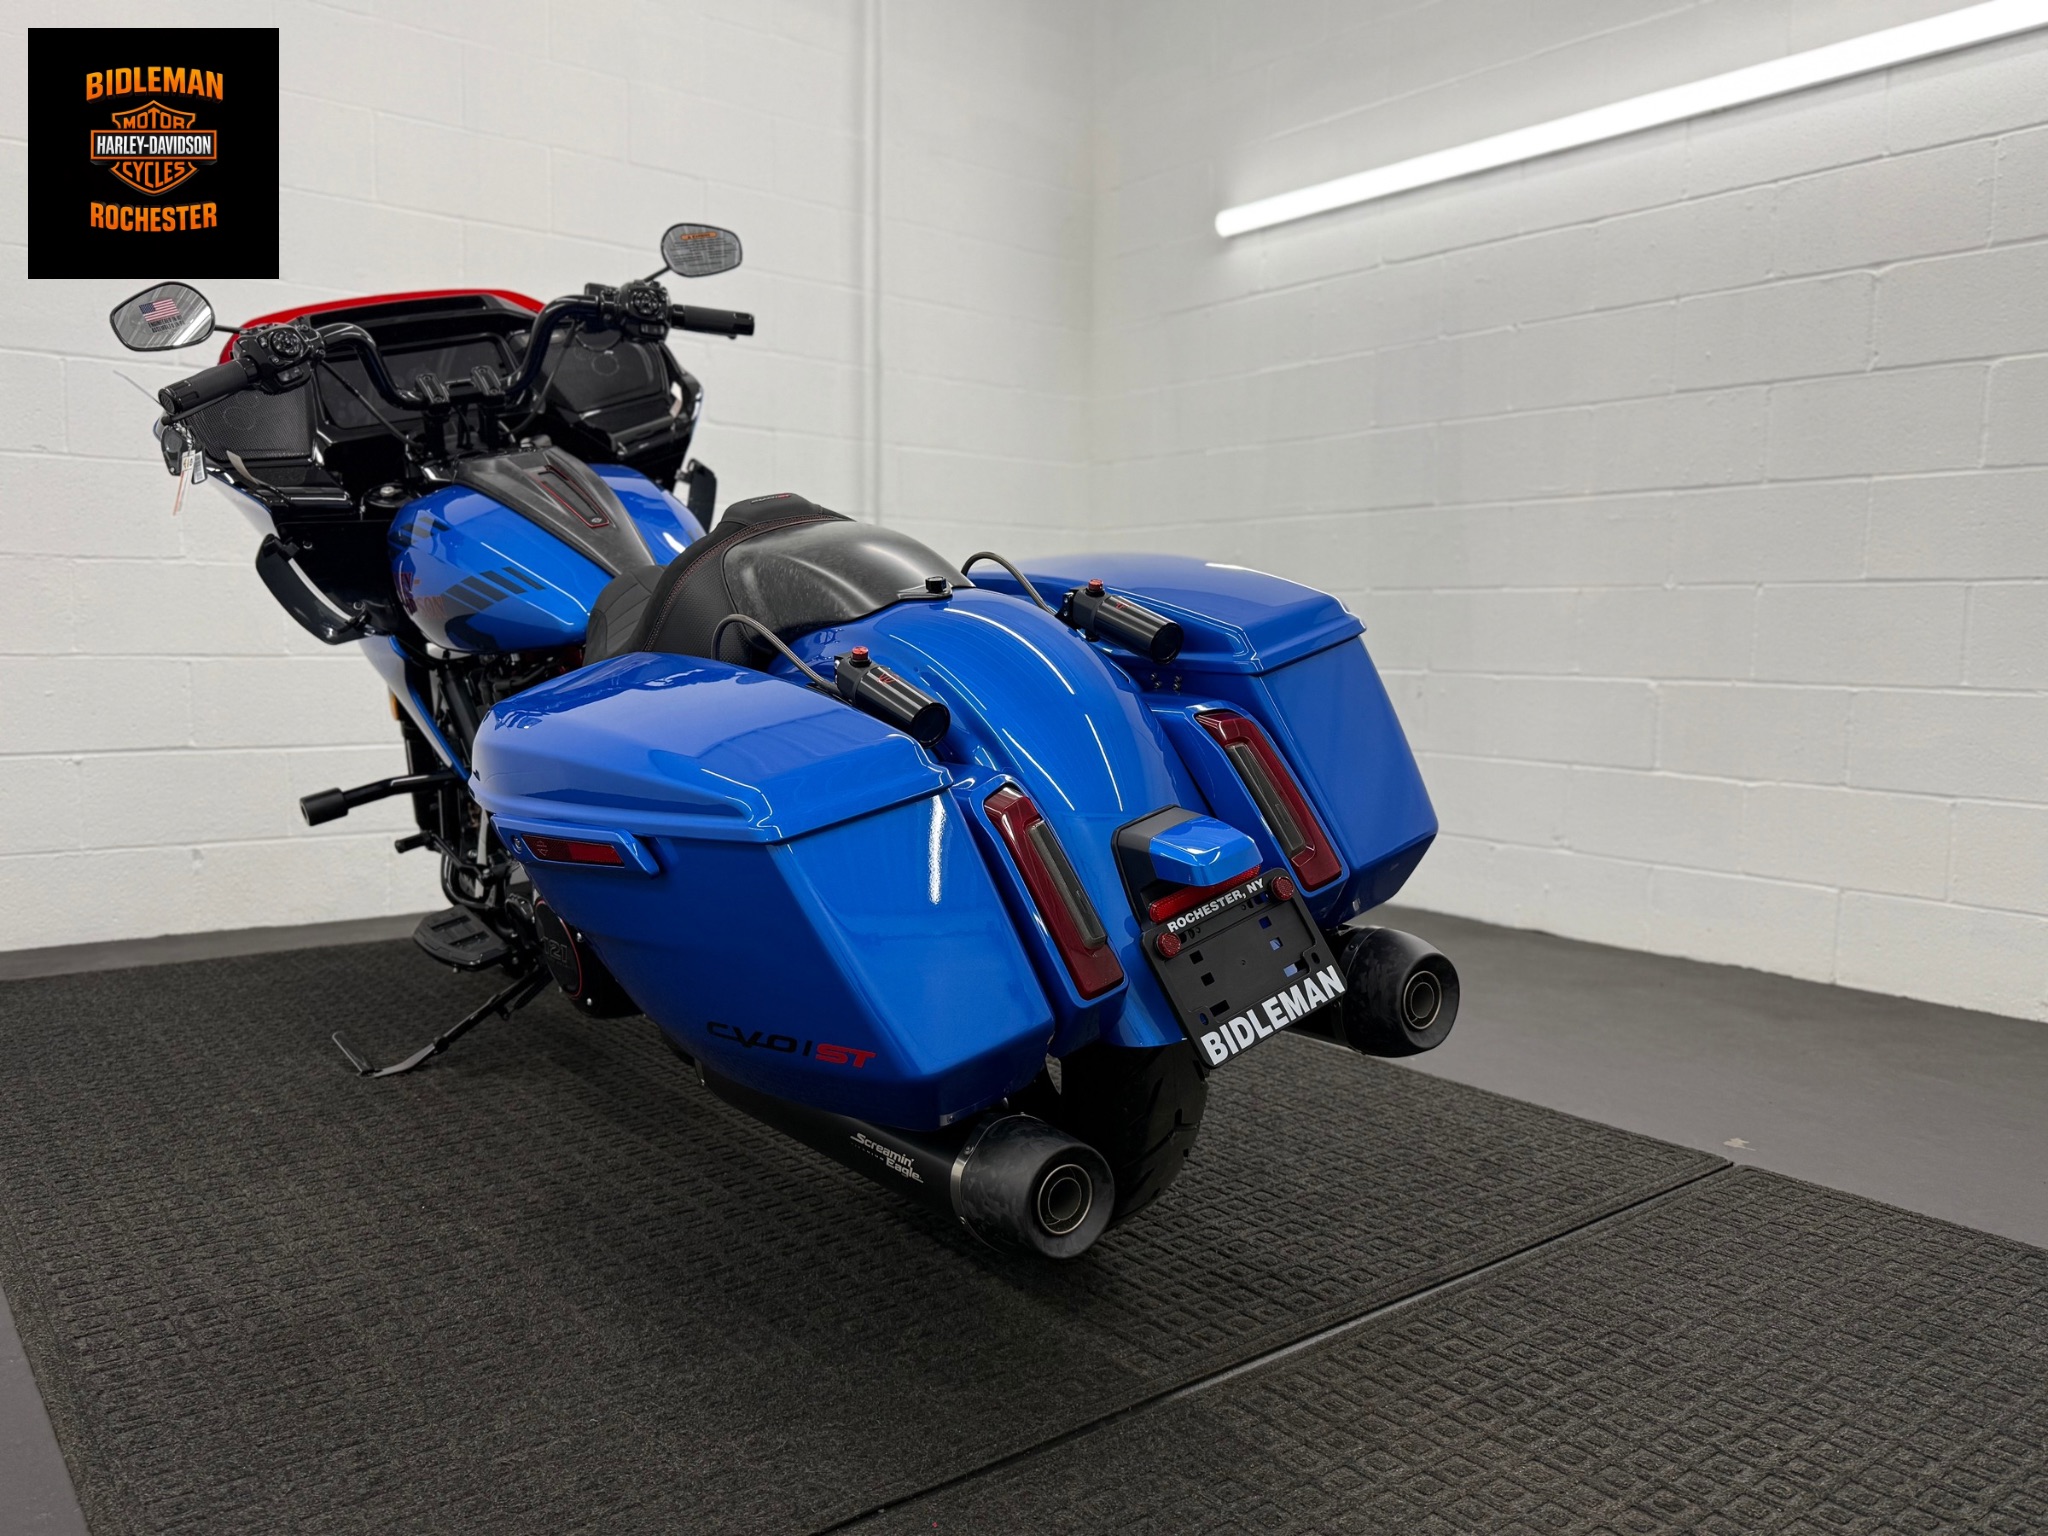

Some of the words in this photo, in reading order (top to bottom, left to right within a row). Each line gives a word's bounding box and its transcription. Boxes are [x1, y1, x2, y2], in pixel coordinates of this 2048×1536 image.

[1167, 888, 1247, 932] ROCHESTER,
[1247, 878, 1264, 894] NY
[1201, 965, 1346, 1065] BIDLEMAN
[816, 1043, 876, 1068] ST
[850, 1132, 915, 1168] Screamin'
[886, 1157, 924, 1183] Eagle
